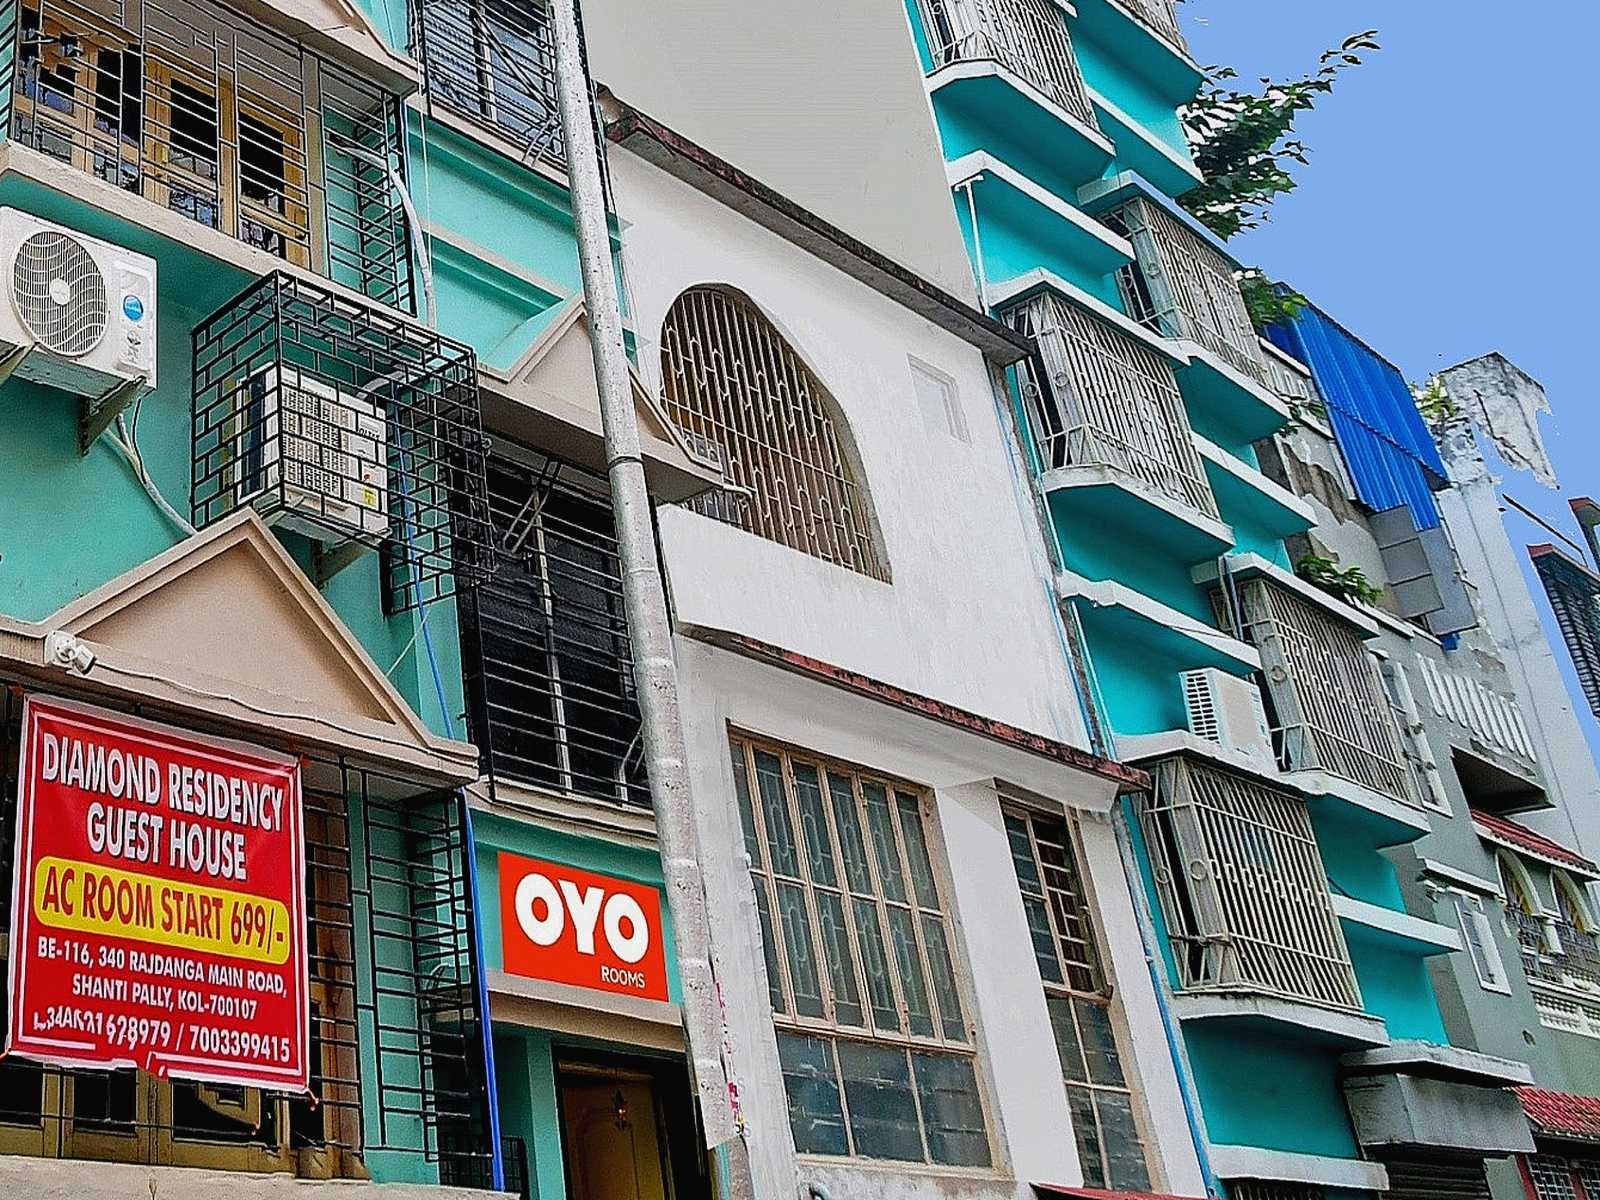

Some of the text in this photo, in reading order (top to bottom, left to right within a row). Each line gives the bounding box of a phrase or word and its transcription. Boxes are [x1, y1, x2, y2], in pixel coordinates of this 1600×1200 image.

[43, 733, 283, 832] DIAMOND RESIDENCY
[87, 802, 247, 880] GUEST HOUSE
[42, 866, 284, 954] AC ROOM START 699/-
[514, 872, 649, 964] OYO
[38, 936, 288, 998] BE-116, 340 RAJDANGA MAIN ROAD,
[72, 973, 258, 1020] SHANTI PALLY, KOL-700107
[601, 965, 646, 989] ROOMS
[189, 1025, 290, 1063] 7003399415
